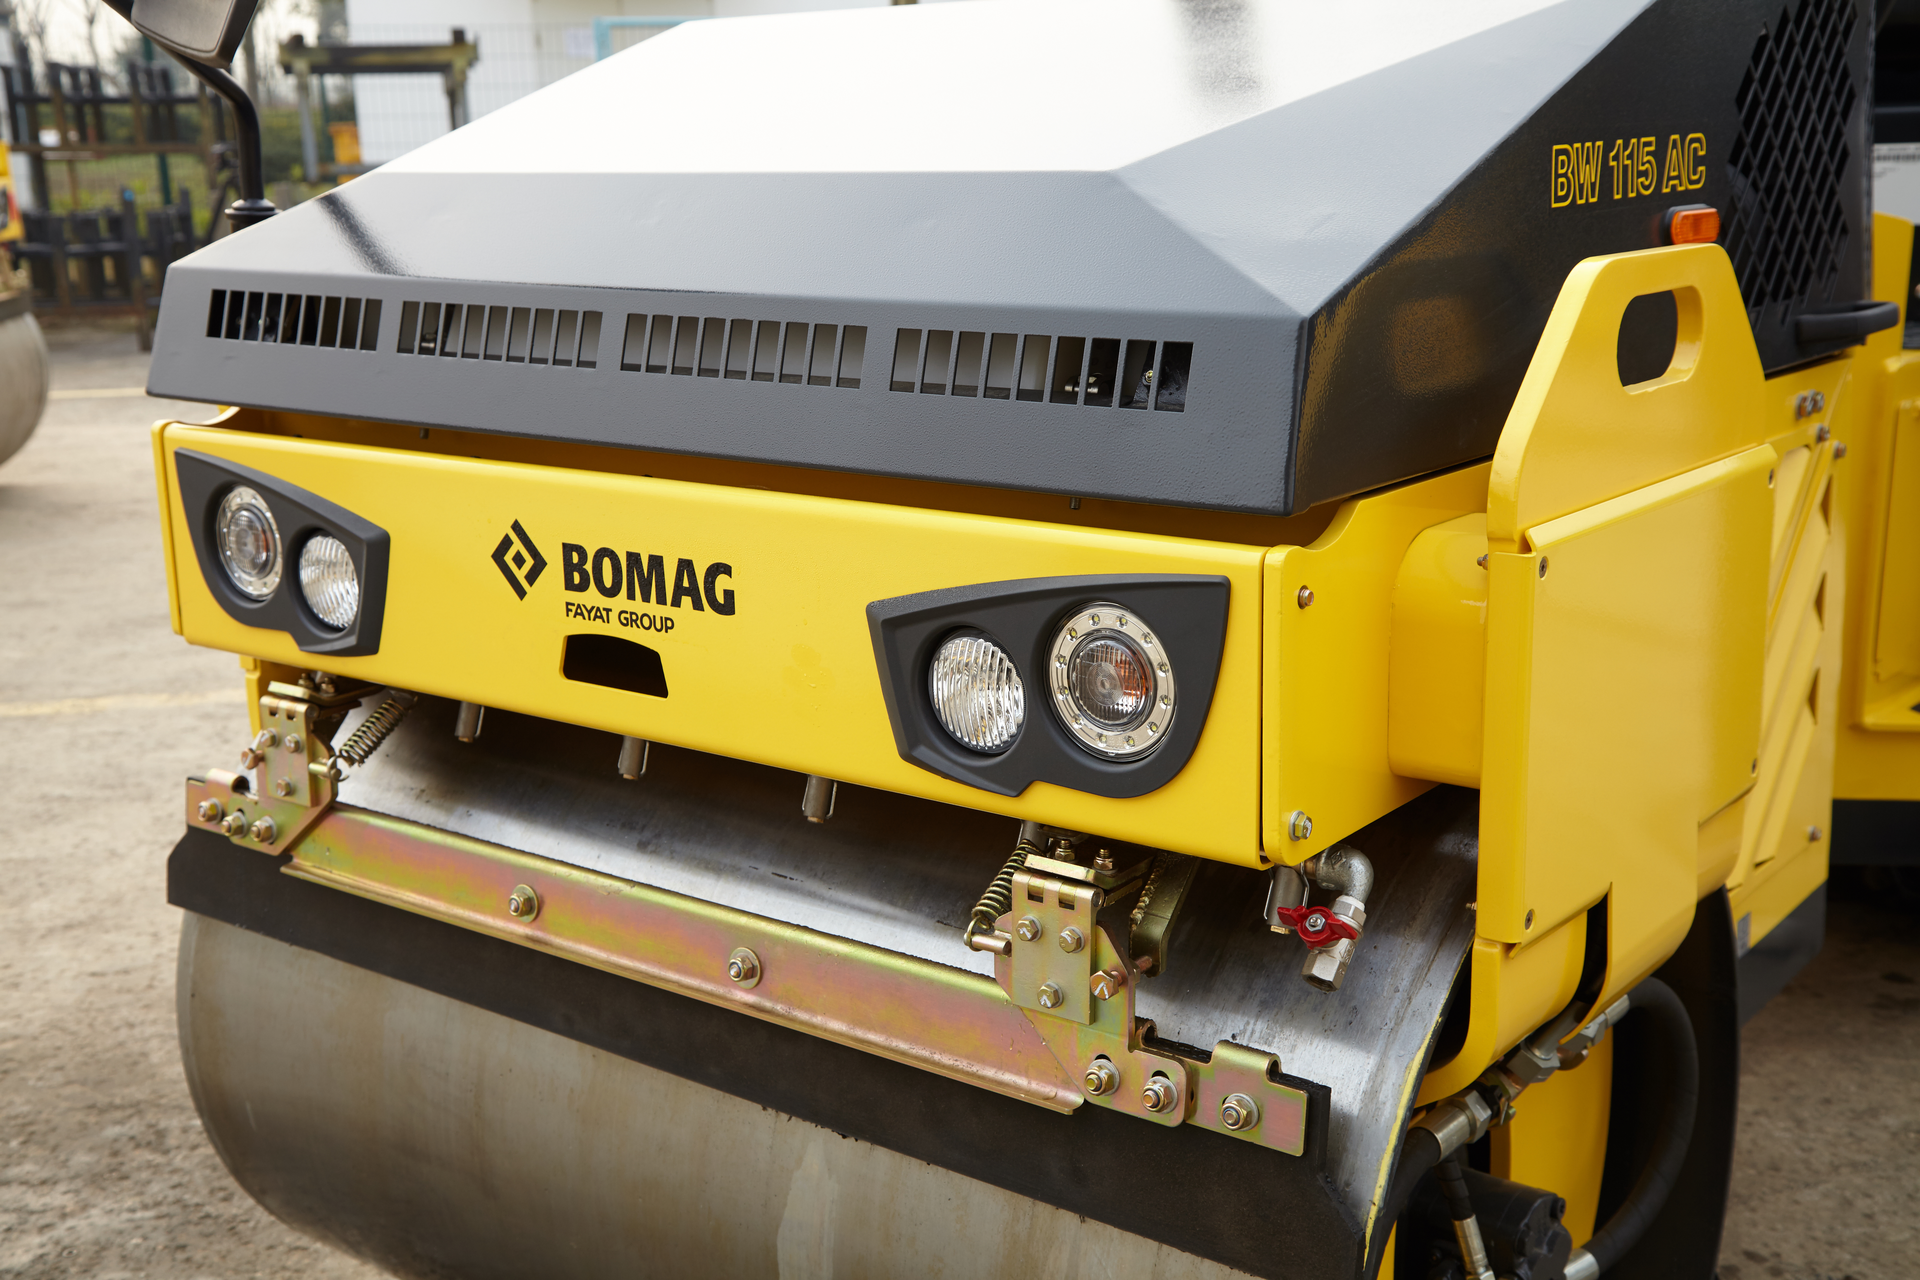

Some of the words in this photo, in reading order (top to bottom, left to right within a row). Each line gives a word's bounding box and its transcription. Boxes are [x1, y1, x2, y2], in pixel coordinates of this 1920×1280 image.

[1551, 141, 1604, 208] BW
[1608, 137, 1657, 200] 115
[1661, 132, 1707, 194] AC
[561, 542, 736, 616] BOMAG
[565, 601, 613, 624] FAYAT
[617, 610, 675, 634] GROUP
